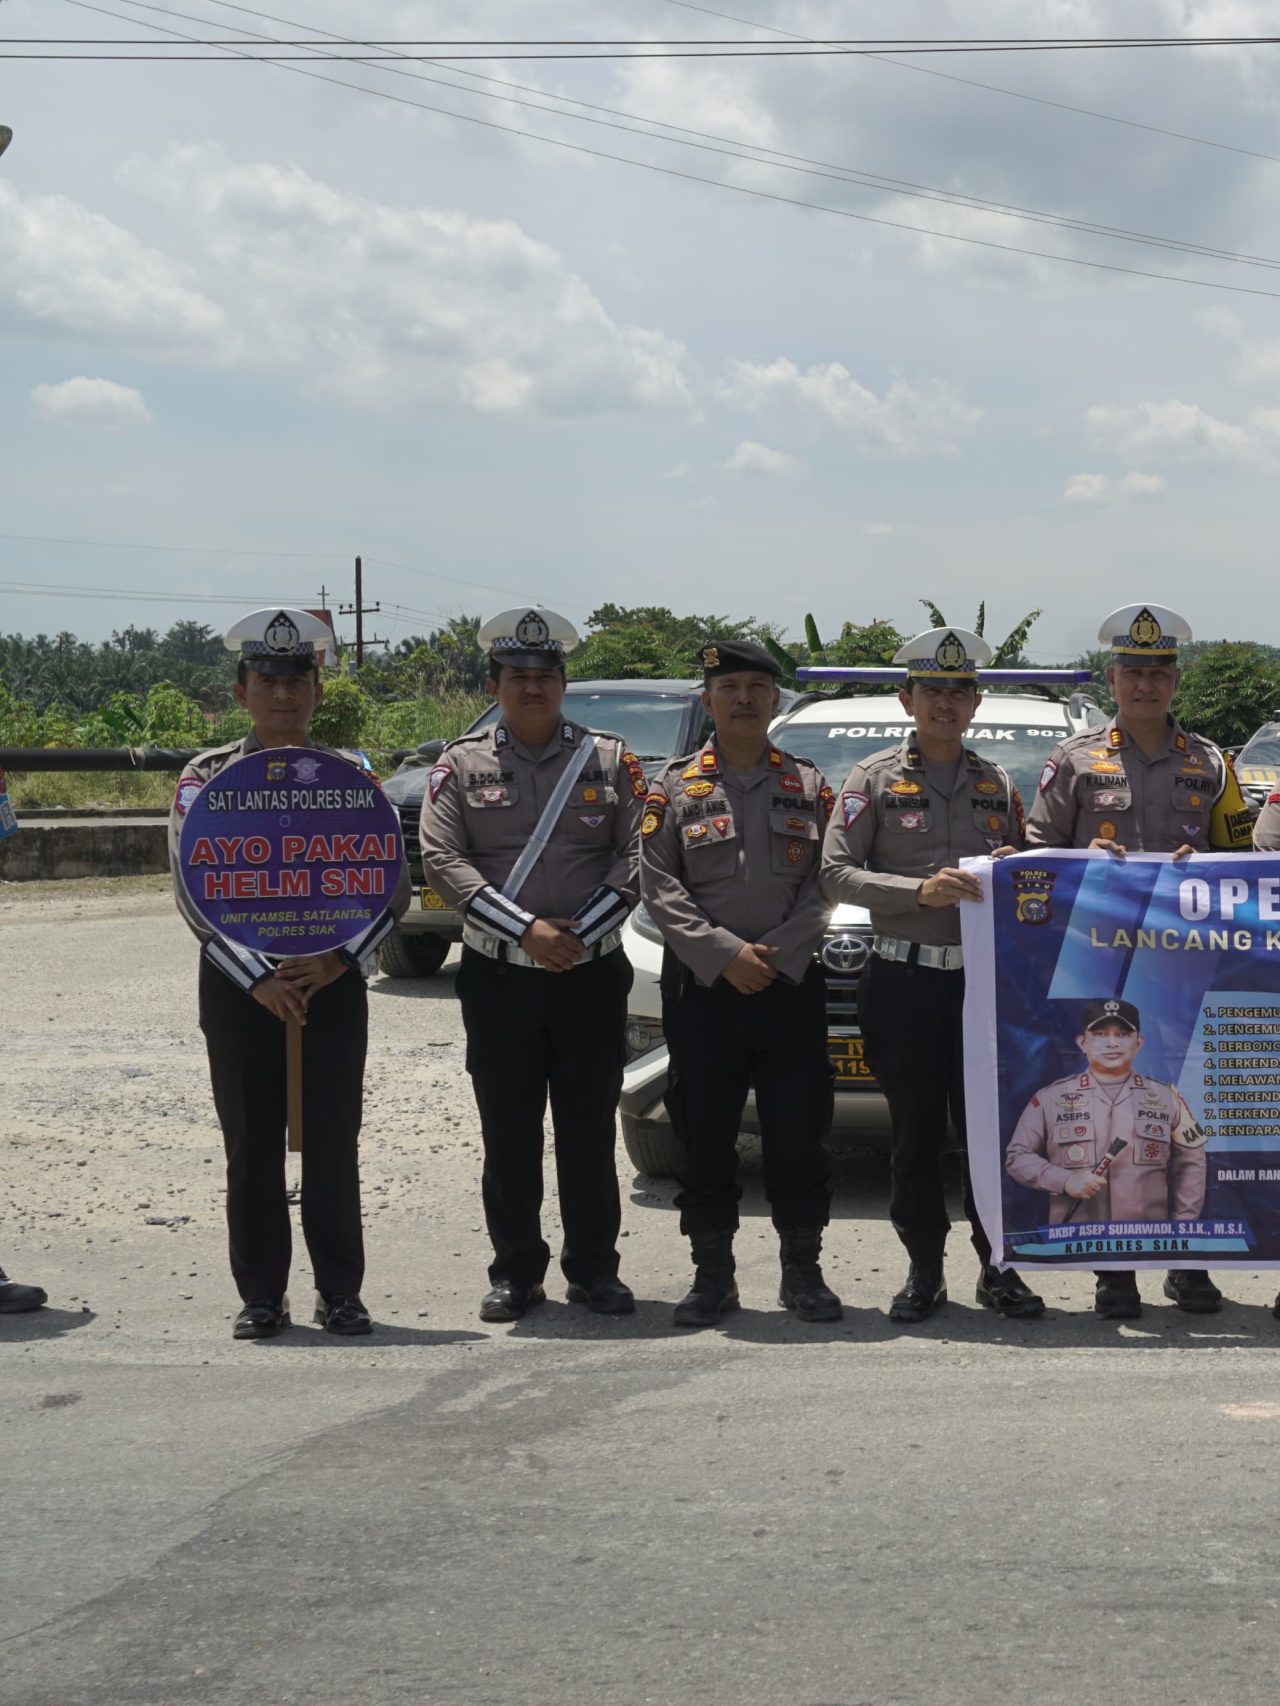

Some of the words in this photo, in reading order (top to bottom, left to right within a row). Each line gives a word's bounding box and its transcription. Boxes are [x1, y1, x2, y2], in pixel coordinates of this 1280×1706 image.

[963, 728, 1015, 741] IAK
[1026, 728, 1068, 739] 903
[1086, 774, 1128, 788] KALIMAN
[1174, 776, 1213, 792] POLRI
[208, 790, 234, 811] SAT
[237, 790, 288, 810] LANTAS
[291, 789, 342, 810] POLRES
[345, 788, 375, 809] SIAK
[189, 836, 272, 866] AYO
[282, 834, 396, 863] PAKAI
[204, 870, 311, 899] HELM
[321, 867, 385, 896] SNI
[220, 912, 249, 924] UNIT
[250, 911, 300, 923] KAMSEL
[303, 909, 373, 921] SATLANTAS
[257, 925, 306, 937] POLRES
[308, 924, 336, 936] SIAK
[1089, 926, 1253, 951] LANCANG
[1203, 1007, 1216, 1019] 1.
[1203, 1024, 1216, 1036] 2.
[1203, 1041, 1216, 1052] 3.
[1203, 1058, 1216, 1069] 4.
[1203, 1075, 1216, 1086] 5.
[1203, 1091, 1216, 1103] 6.
[1138, 1109, 1170, 1122] POLRI
[1203, 1108, 1216, 1120] 7.
[1203, 1125, 1216, 1137] 8.
[1217, 1169, 1256, 1182] DALAM
[1048, 1226, 1077, 1240] AKBP
[1078, 1225, 1105, 1237] ASEP
[1108, 1223, 1175, 1237] SUJARWADI,
[1214, 1223, 1246, 1235] M.S.I.
[1064, 1240, 1144, 1254] KAPOLRES
[1152, 1239, 1191, 1251] SIAK
